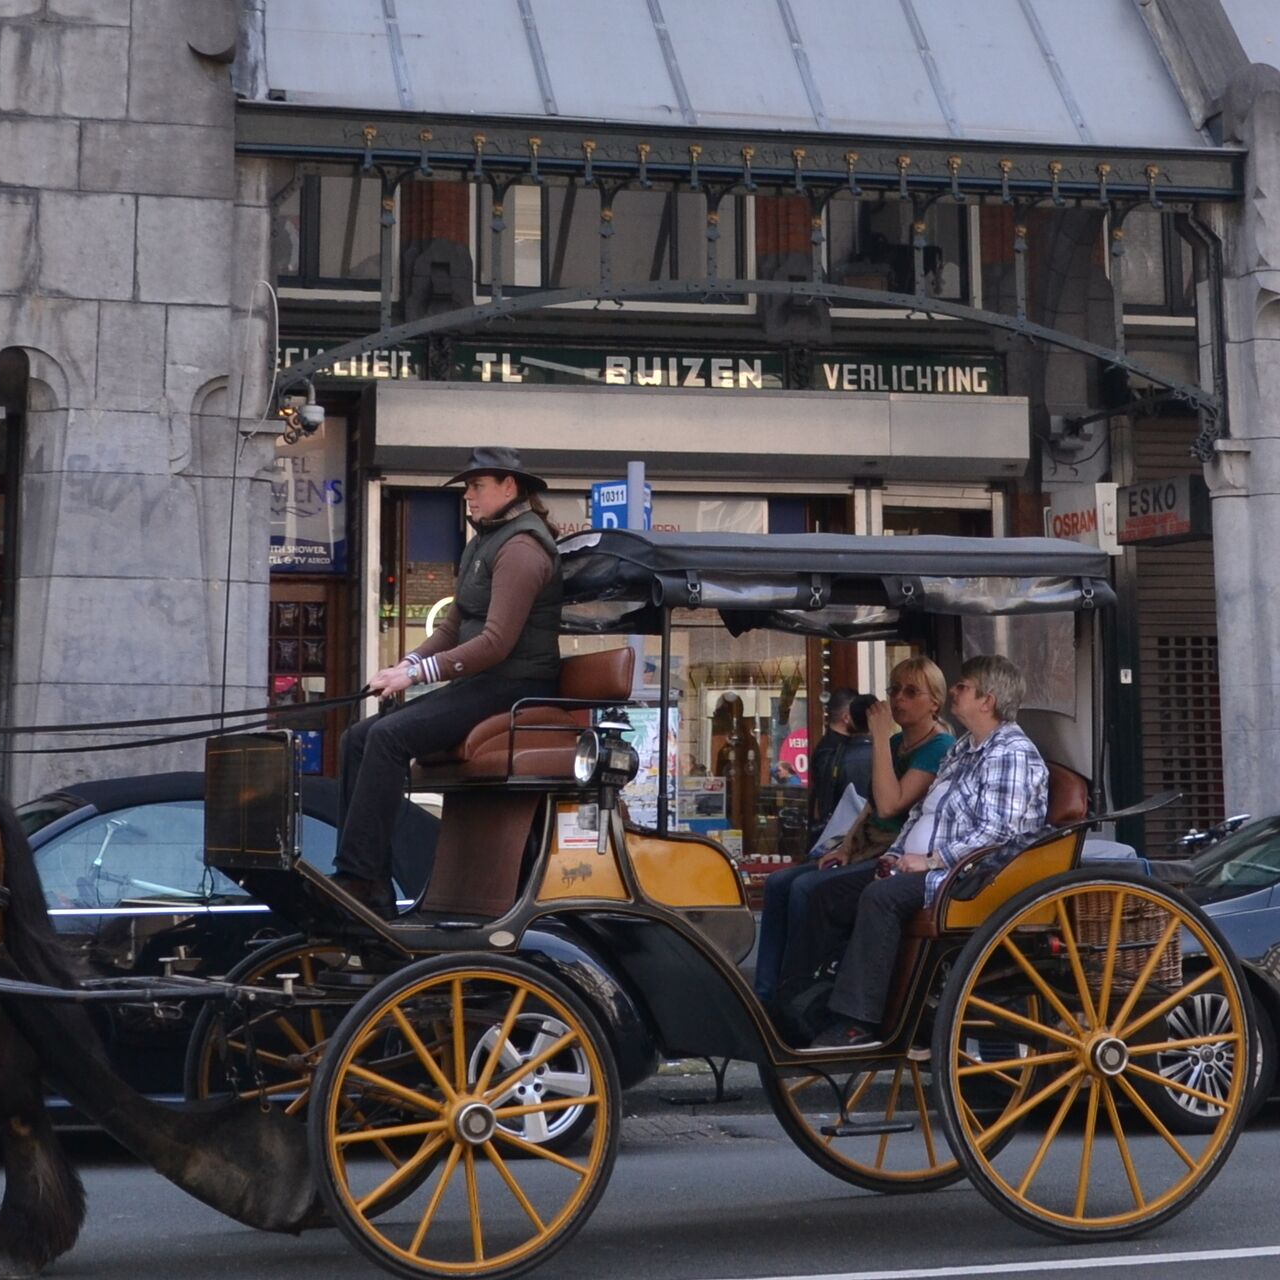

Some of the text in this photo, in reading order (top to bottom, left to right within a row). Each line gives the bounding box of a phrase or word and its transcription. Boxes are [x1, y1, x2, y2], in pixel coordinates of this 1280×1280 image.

[606, 356, 762, 388] BUIZEN
[823, 363, 988, 393] VERLICHTING
[601, 489, 625, 504] 10311
[1128, 483, 1177, 517] ESKO
[1053, 508, 1097, 538] OSRAM
